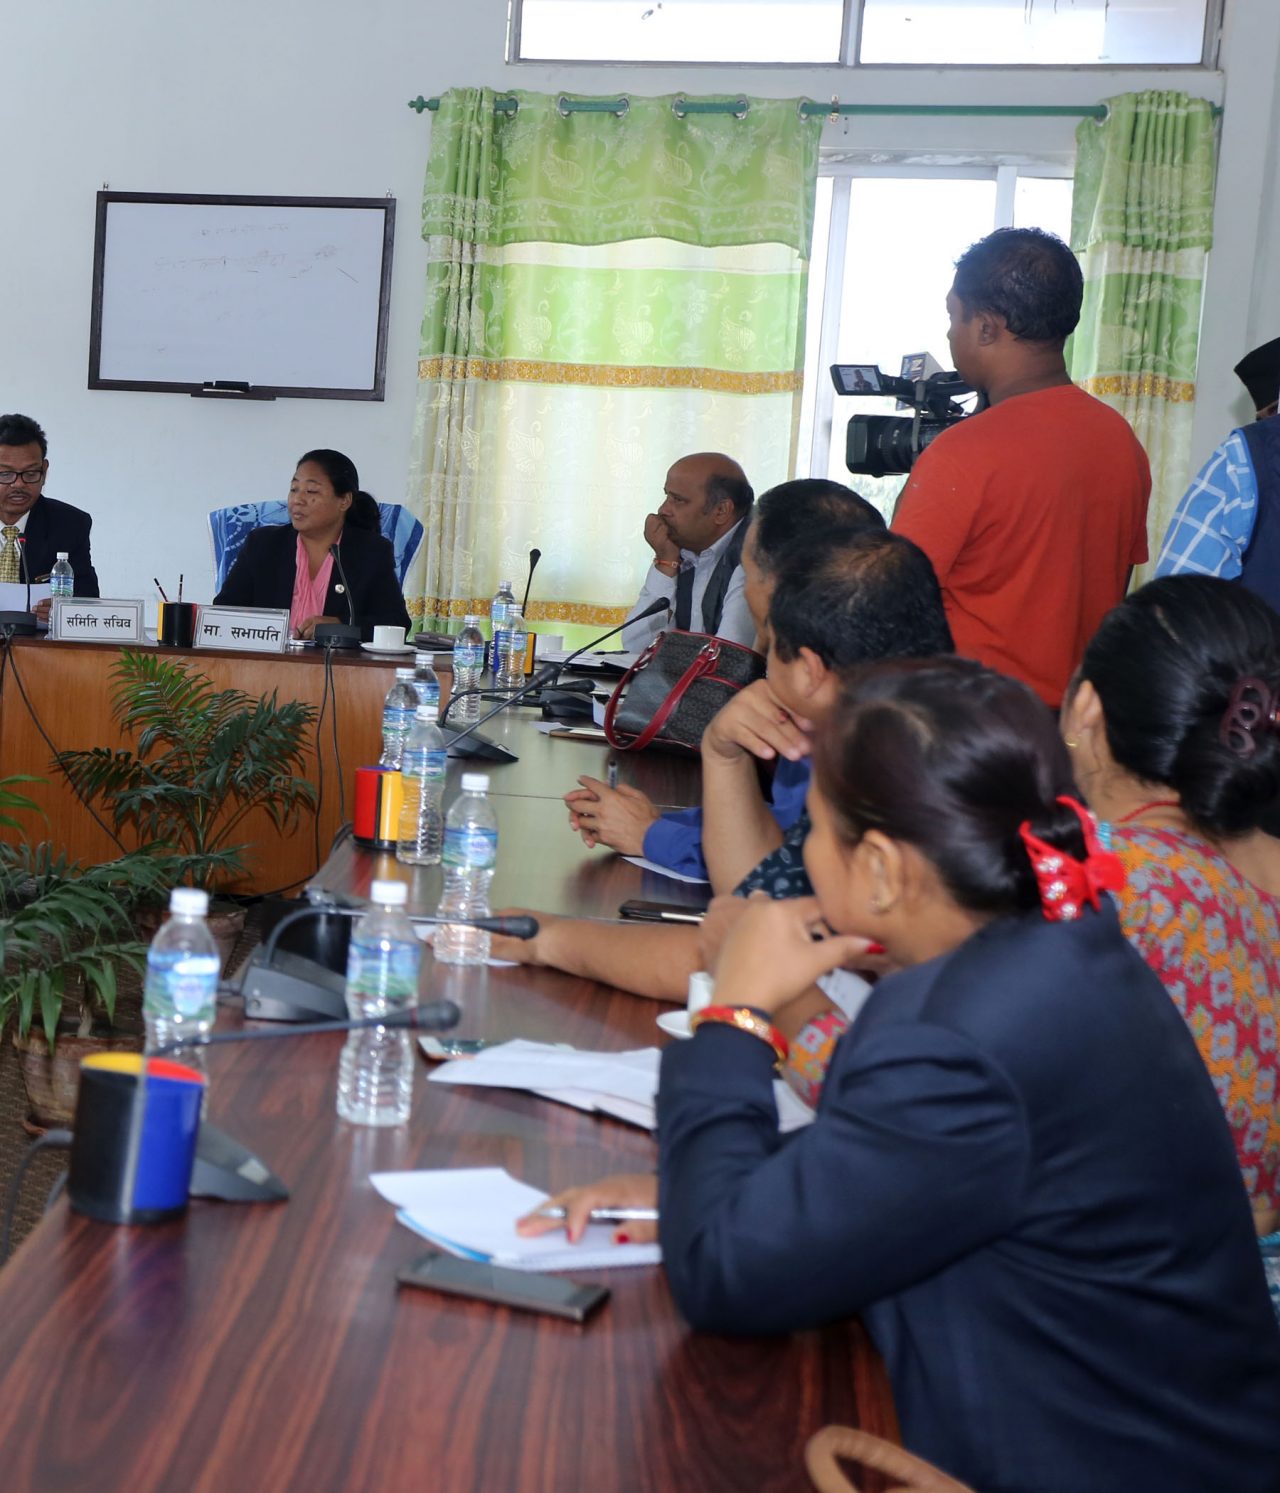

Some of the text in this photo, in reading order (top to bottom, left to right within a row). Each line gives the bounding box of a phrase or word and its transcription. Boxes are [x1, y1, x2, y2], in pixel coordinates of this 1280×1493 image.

[66, 613, 132, 629] समिति सचिव
[231, 625, 281, 642] सभापति
